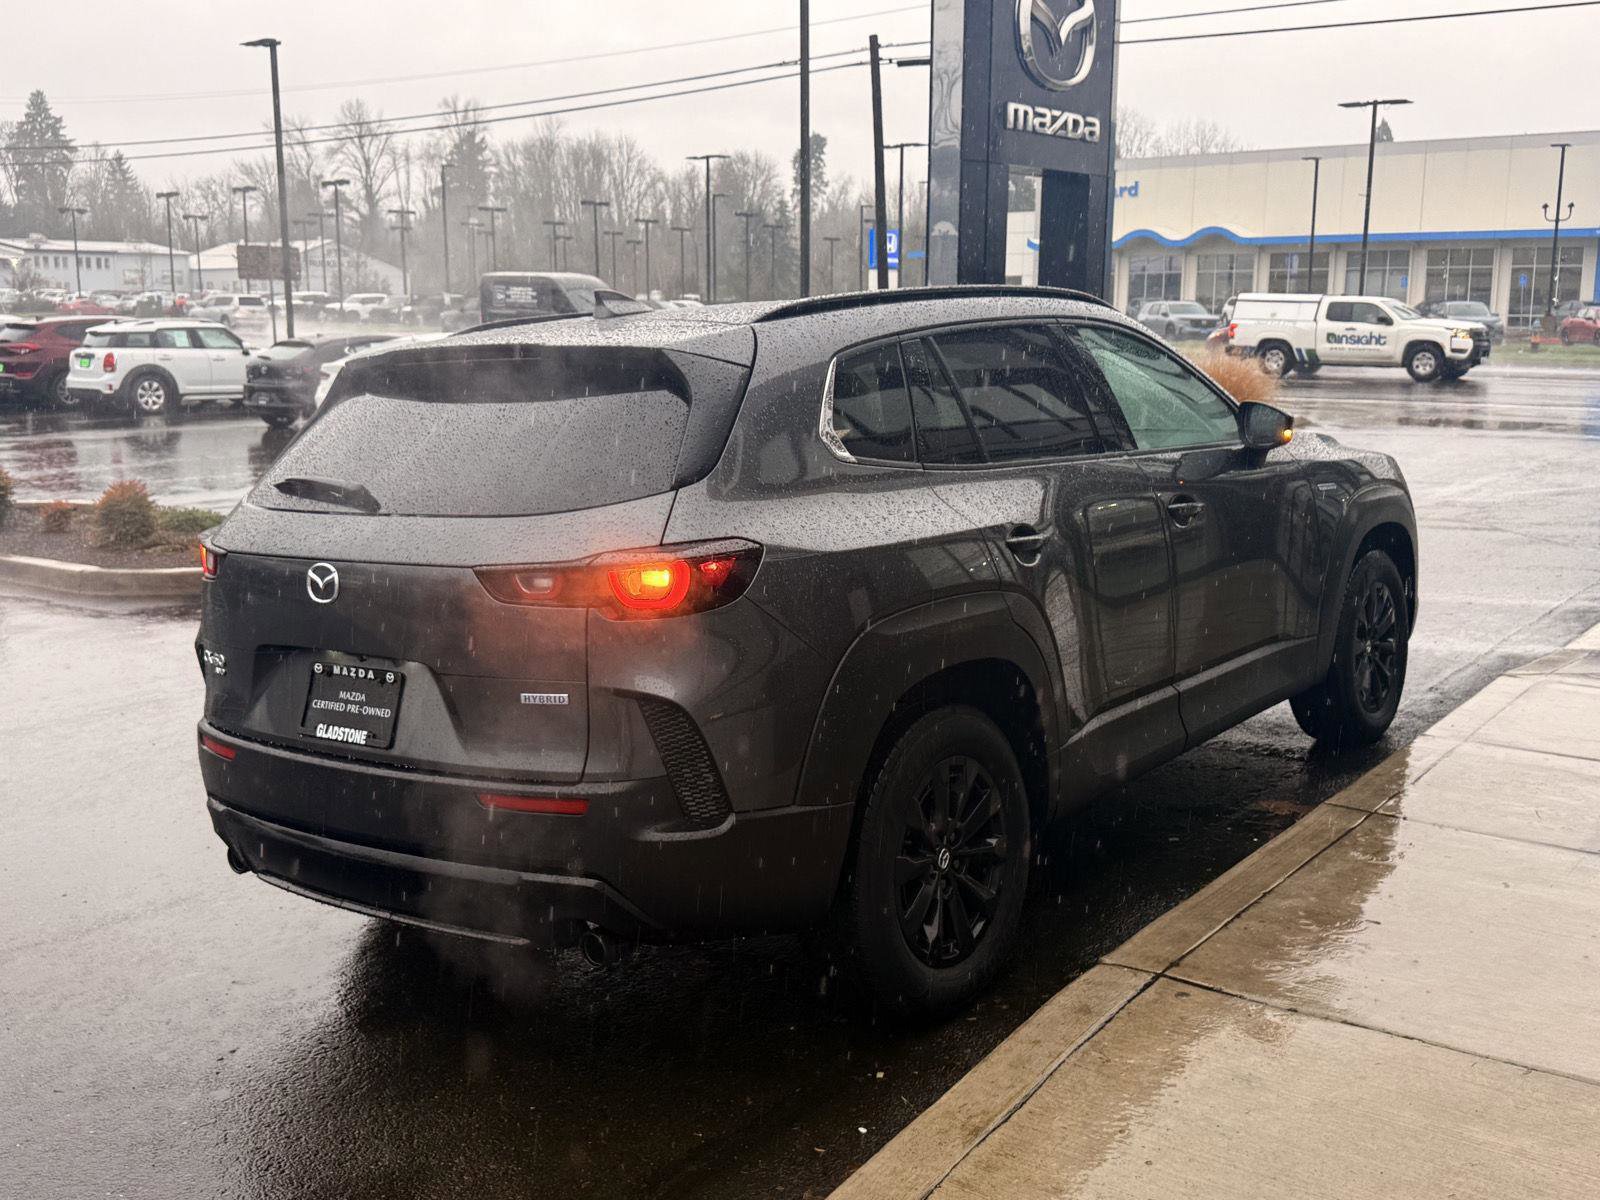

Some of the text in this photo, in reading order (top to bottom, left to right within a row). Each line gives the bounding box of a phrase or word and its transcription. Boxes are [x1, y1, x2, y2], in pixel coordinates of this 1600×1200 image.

[1006, 101, 1100, 142] mazda
[333, 665, 374, 679] MAZDA
[339, 691, 366, 702] MAZDA
[523, 695, 566, 704] HYBRID
[312, 699, 391, 718] CERTIFIED PRE-OWNED
[316, 723, 367, 745] GLADSTONE
